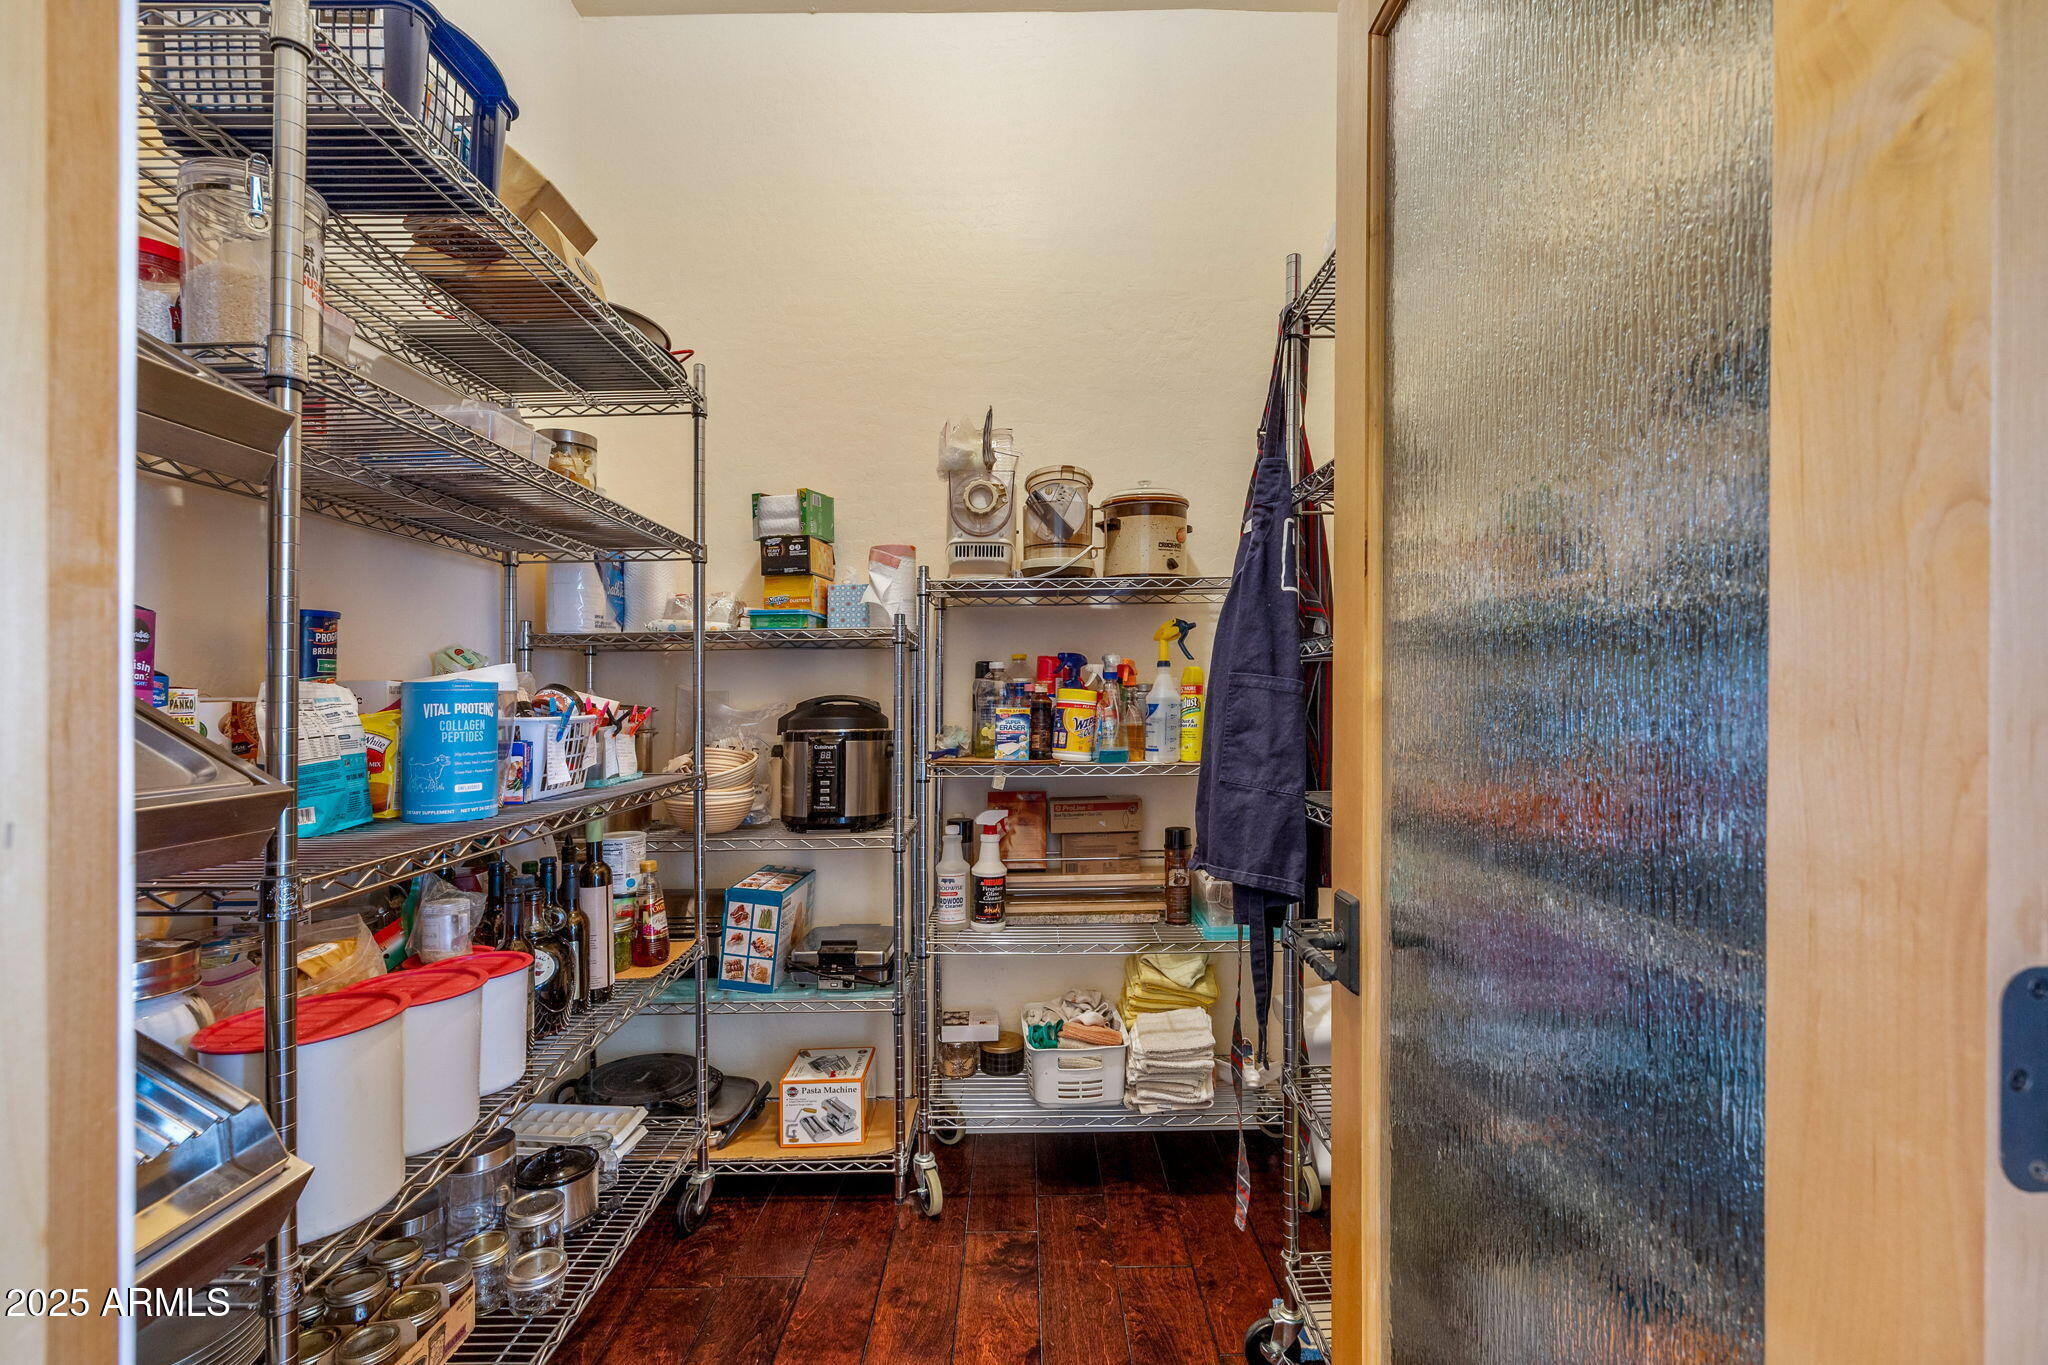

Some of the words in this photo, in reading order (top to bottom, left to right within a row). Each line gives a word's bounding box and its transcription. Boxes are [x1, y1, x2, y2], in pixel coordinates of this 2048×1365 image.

[315, 632, 338, 643] PROG
[312, 647, 334, 656] BREAD
[133, 660, 151, 673] isin
[169, 698, 195, 711] PANKO
[423, 703, 451, 719] VITAL
[454, 702, 495, 718] PROTEINS
[439, 719, 486, 732] COLLAGEN
[441, 730, 485, 743] PEPTIDES
[801, 1087, 822, 1095] Pasta
[823, 1085, 858, 1095] Machine
